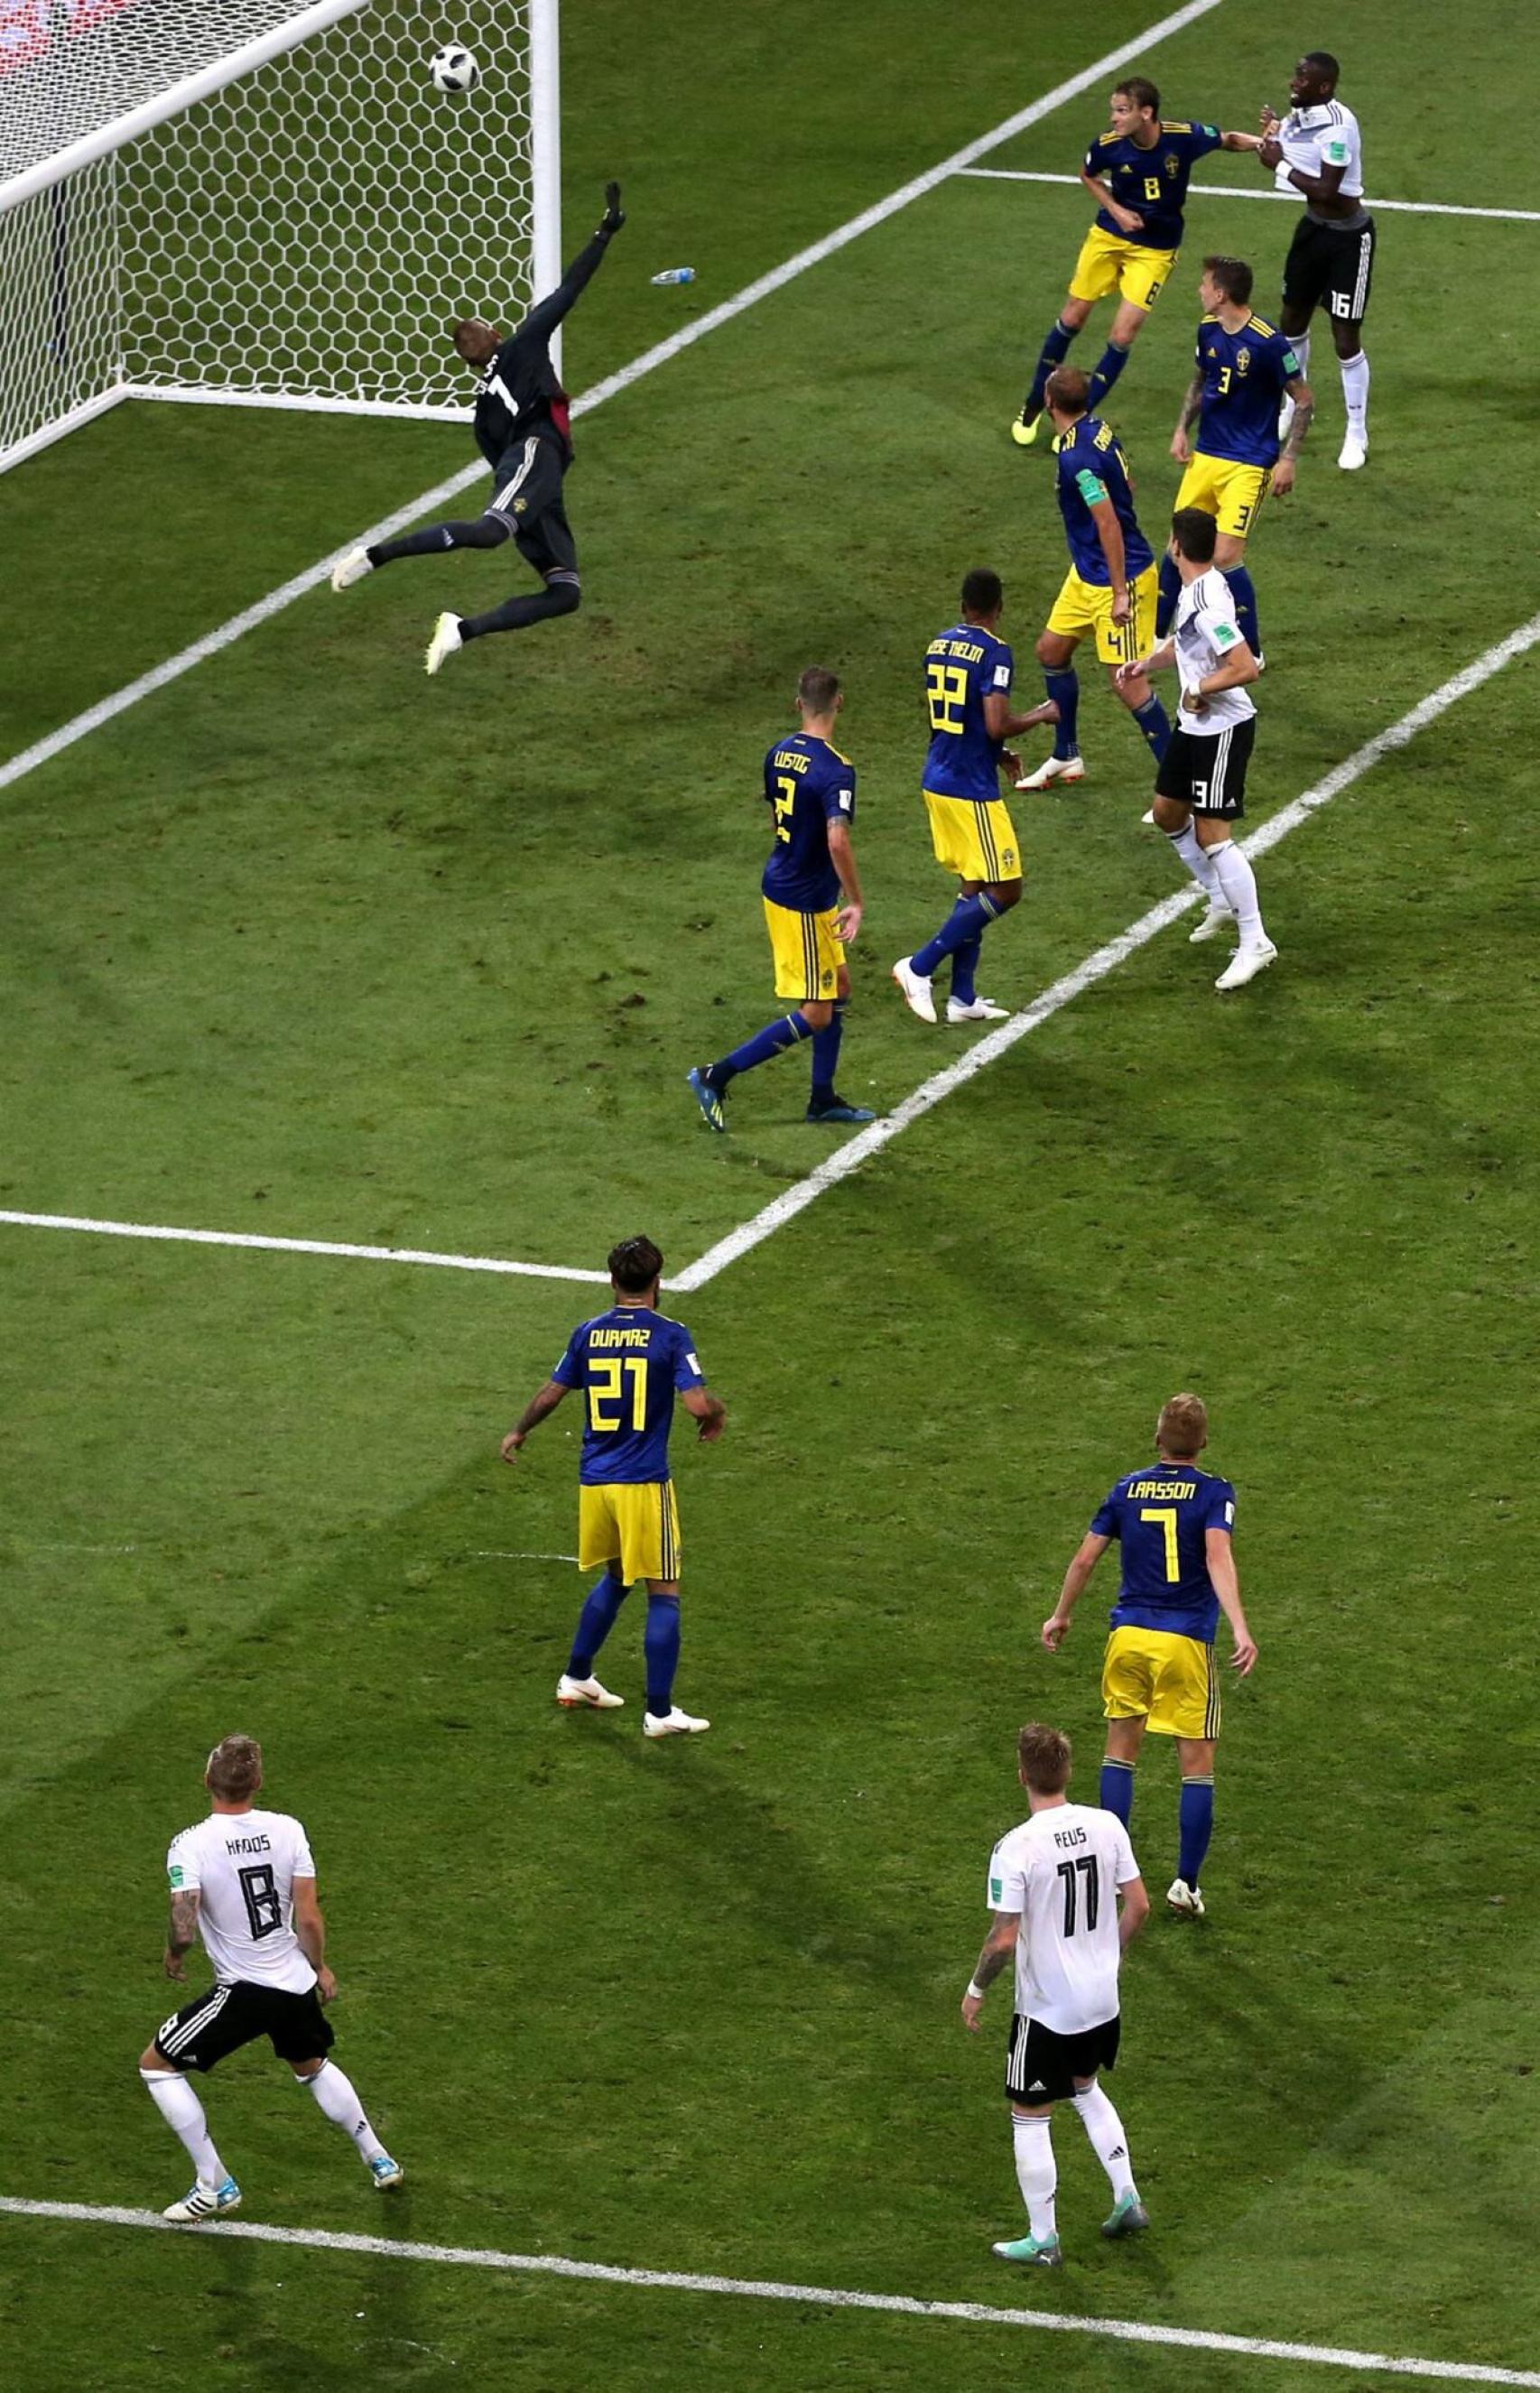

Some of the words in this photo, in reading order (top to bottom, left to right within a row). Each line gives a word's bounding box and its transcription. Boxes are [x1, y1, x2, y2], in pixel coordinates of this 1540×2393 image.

[1144, 177, 1161, 200] 8
[1145, 281, 1160, 305] 8
[1331, 289, 1350, 319] 16
[1218, 366, 1231, 394] 3
[487, 374, 520, 417] 1
[1233, 505, 1251, 531] 3
[1108, 631, 1121, 656] 4
[927, 663, 968, 734] 22
[774, 750, 812, 774] LUSTIG
[775, 776, 796, 844] 2
[589, 1328, 652, 1348] DURMAZ
[589, 1357, 648, 1432] 21
[1127, 1480, 1196, 1500] LARSSON
[1140, 1507, 1181, 1583] 7
[1053, 1826, 1088, 1849] REUS
[237, 1863, 283, 1942] 8
[1056, 1854, 1099, 1939] 11
[158, 2012, 179, 2043] 8
